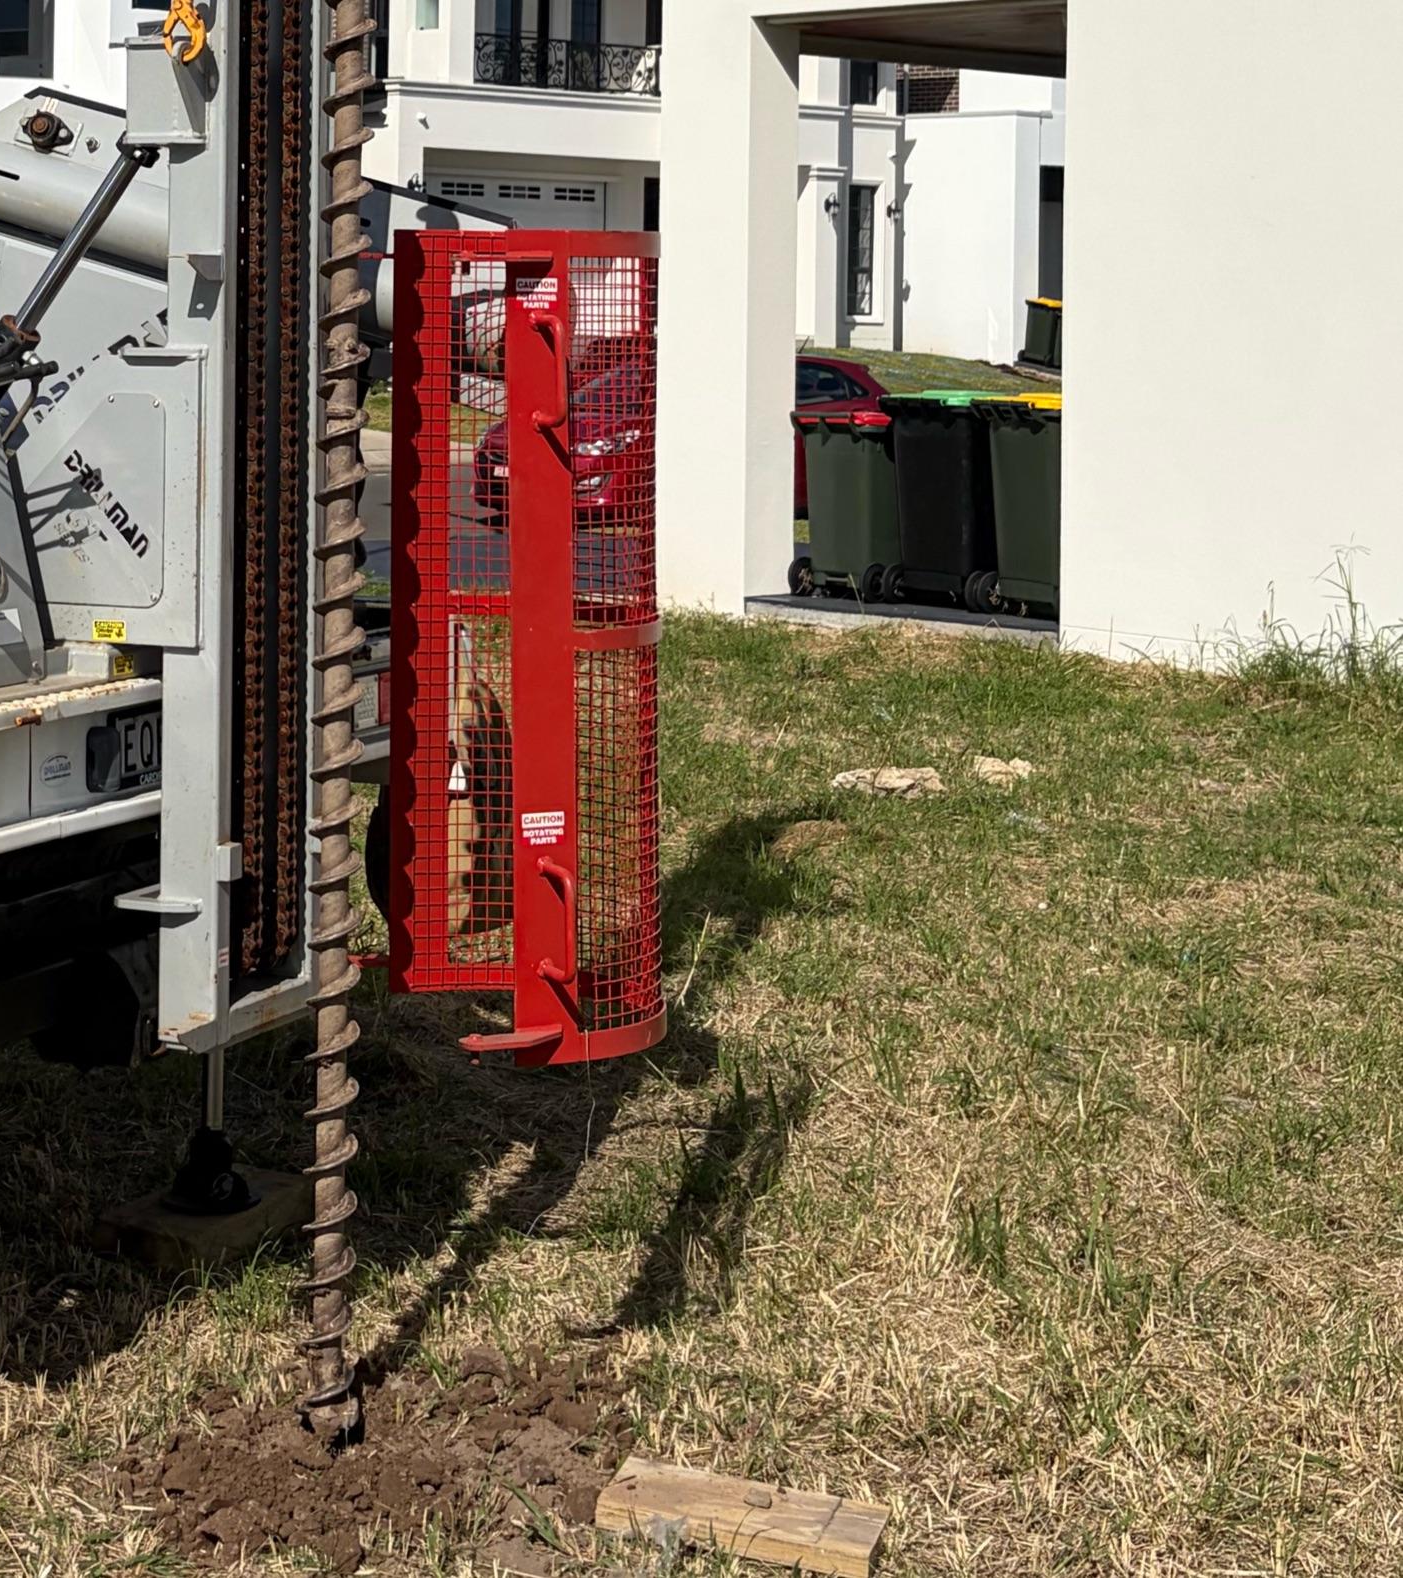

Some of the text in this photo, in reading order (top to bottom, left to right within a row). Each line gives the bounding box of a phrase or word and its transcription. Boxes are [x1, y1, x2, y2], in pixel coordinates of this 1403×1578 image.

[517, 281, 556, 289] CAUTION
[523, 301, 549, 309] PARTS
[524, 815, 563, 825] CAUTION
[523, 828, 564, 838] ROTATING
[530, 836, 557, 846] PARTS
